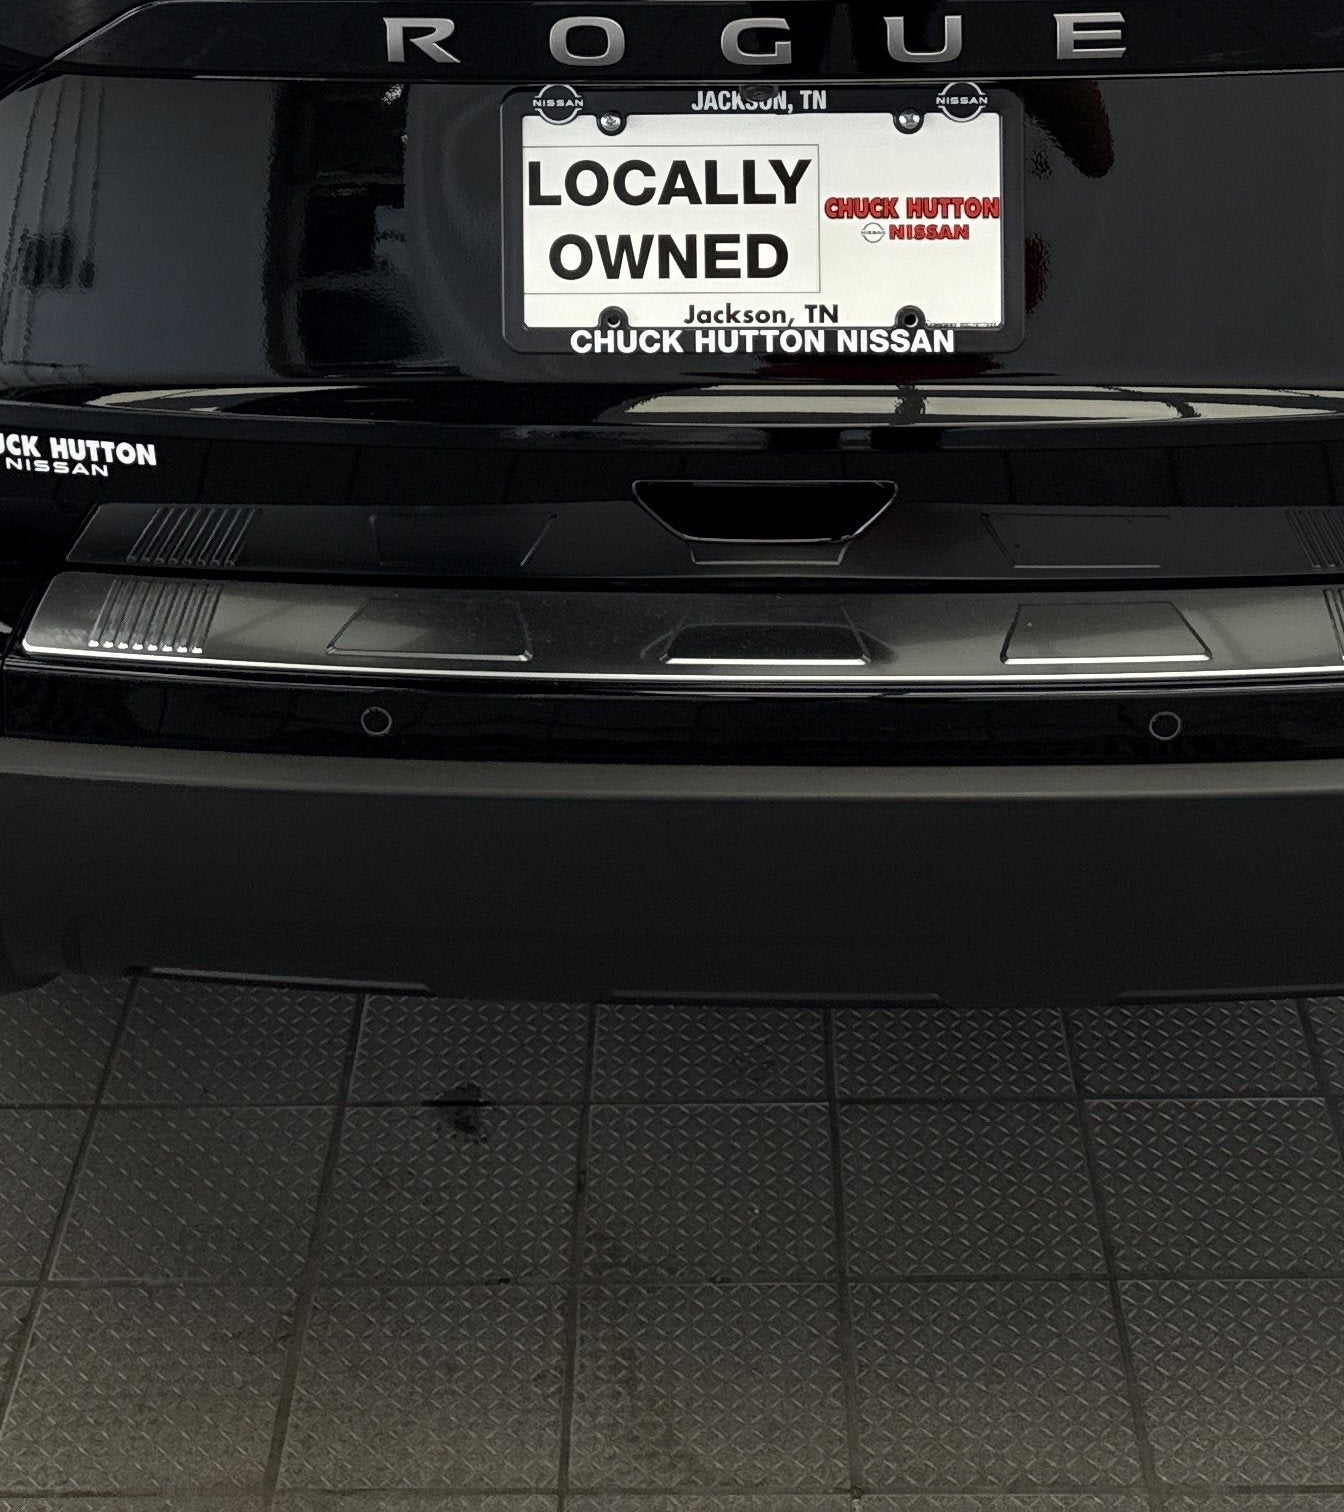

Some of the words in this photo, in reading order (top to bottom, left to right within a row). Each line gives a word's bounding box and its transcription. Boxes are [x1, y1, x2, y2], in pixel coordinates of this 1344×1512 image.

[382, 11, 1127, 66] ROGUE
[532, 99, 584, 107] NISSAN
[799, 90, 827, 110] TN
[936, 96, 988, 105] NISSAN
[528, 159, 811, 206] LOCALLY
[824, 197, 900, 219] CHUCK
[906, 197, 1000, 219] HUTTON
[889, 224, 970, 240] NISSAN
[549, 233, 789, 280] OWNED
[684, 303, 794, 326] Jackson,
[804, 304, 839, 324] TN
[570, 329, 684, 354] CHUCK
[695, 329, 825, 354] HUTTON
[837, 329, 955, 354] NISSAN
[49, 437, 157, 466] HUTTON
[5, 457, 109, 477] NISSAN
